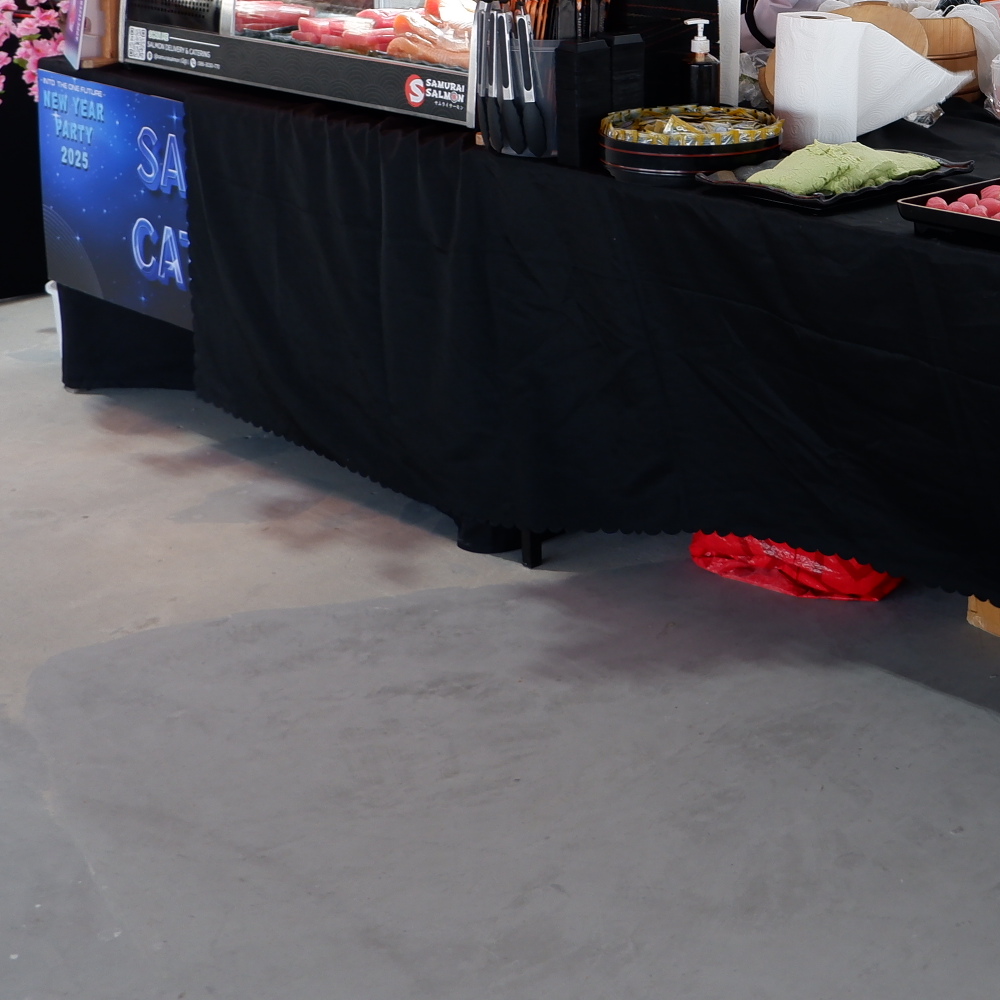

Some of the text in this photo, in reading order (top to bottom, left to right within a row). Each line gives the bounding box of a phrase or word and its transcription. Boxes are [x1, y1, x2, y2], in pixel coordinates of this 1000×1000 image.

[426, 78, 465, 92] SAMURAI
[426, 88, 465, 103] SALMON
[43, 89, 105, 124] NEW YEAR
[54, 115, 94, 146] PARTY
[60, 145, 89, 171] 2025
